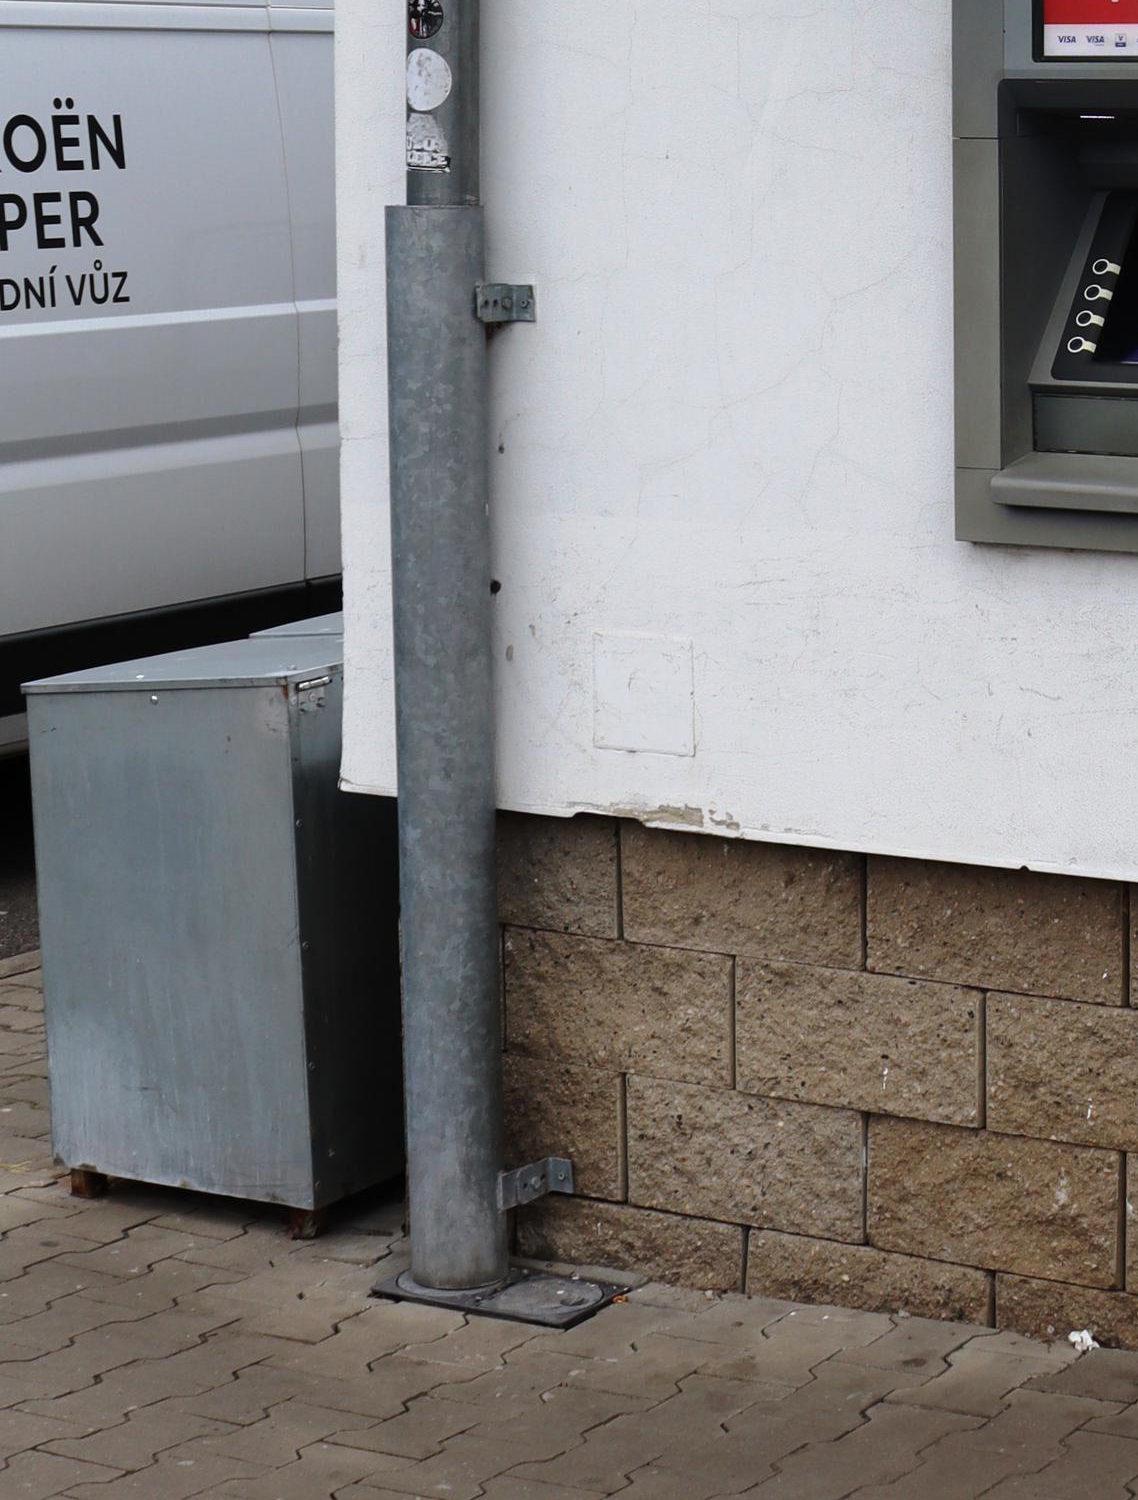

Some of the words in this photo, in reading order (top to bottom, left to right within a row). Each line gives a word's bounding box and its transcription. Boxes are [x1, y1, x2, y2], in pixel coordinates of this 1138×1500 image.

[1057, 35, 1077, 43] VISA
[1086, 35, 1105, 43] VISA
[0, 97, 126, 173] OËN
[0, 190, 104, 252] PER
[65, 259, 131, 307] VŮZ
